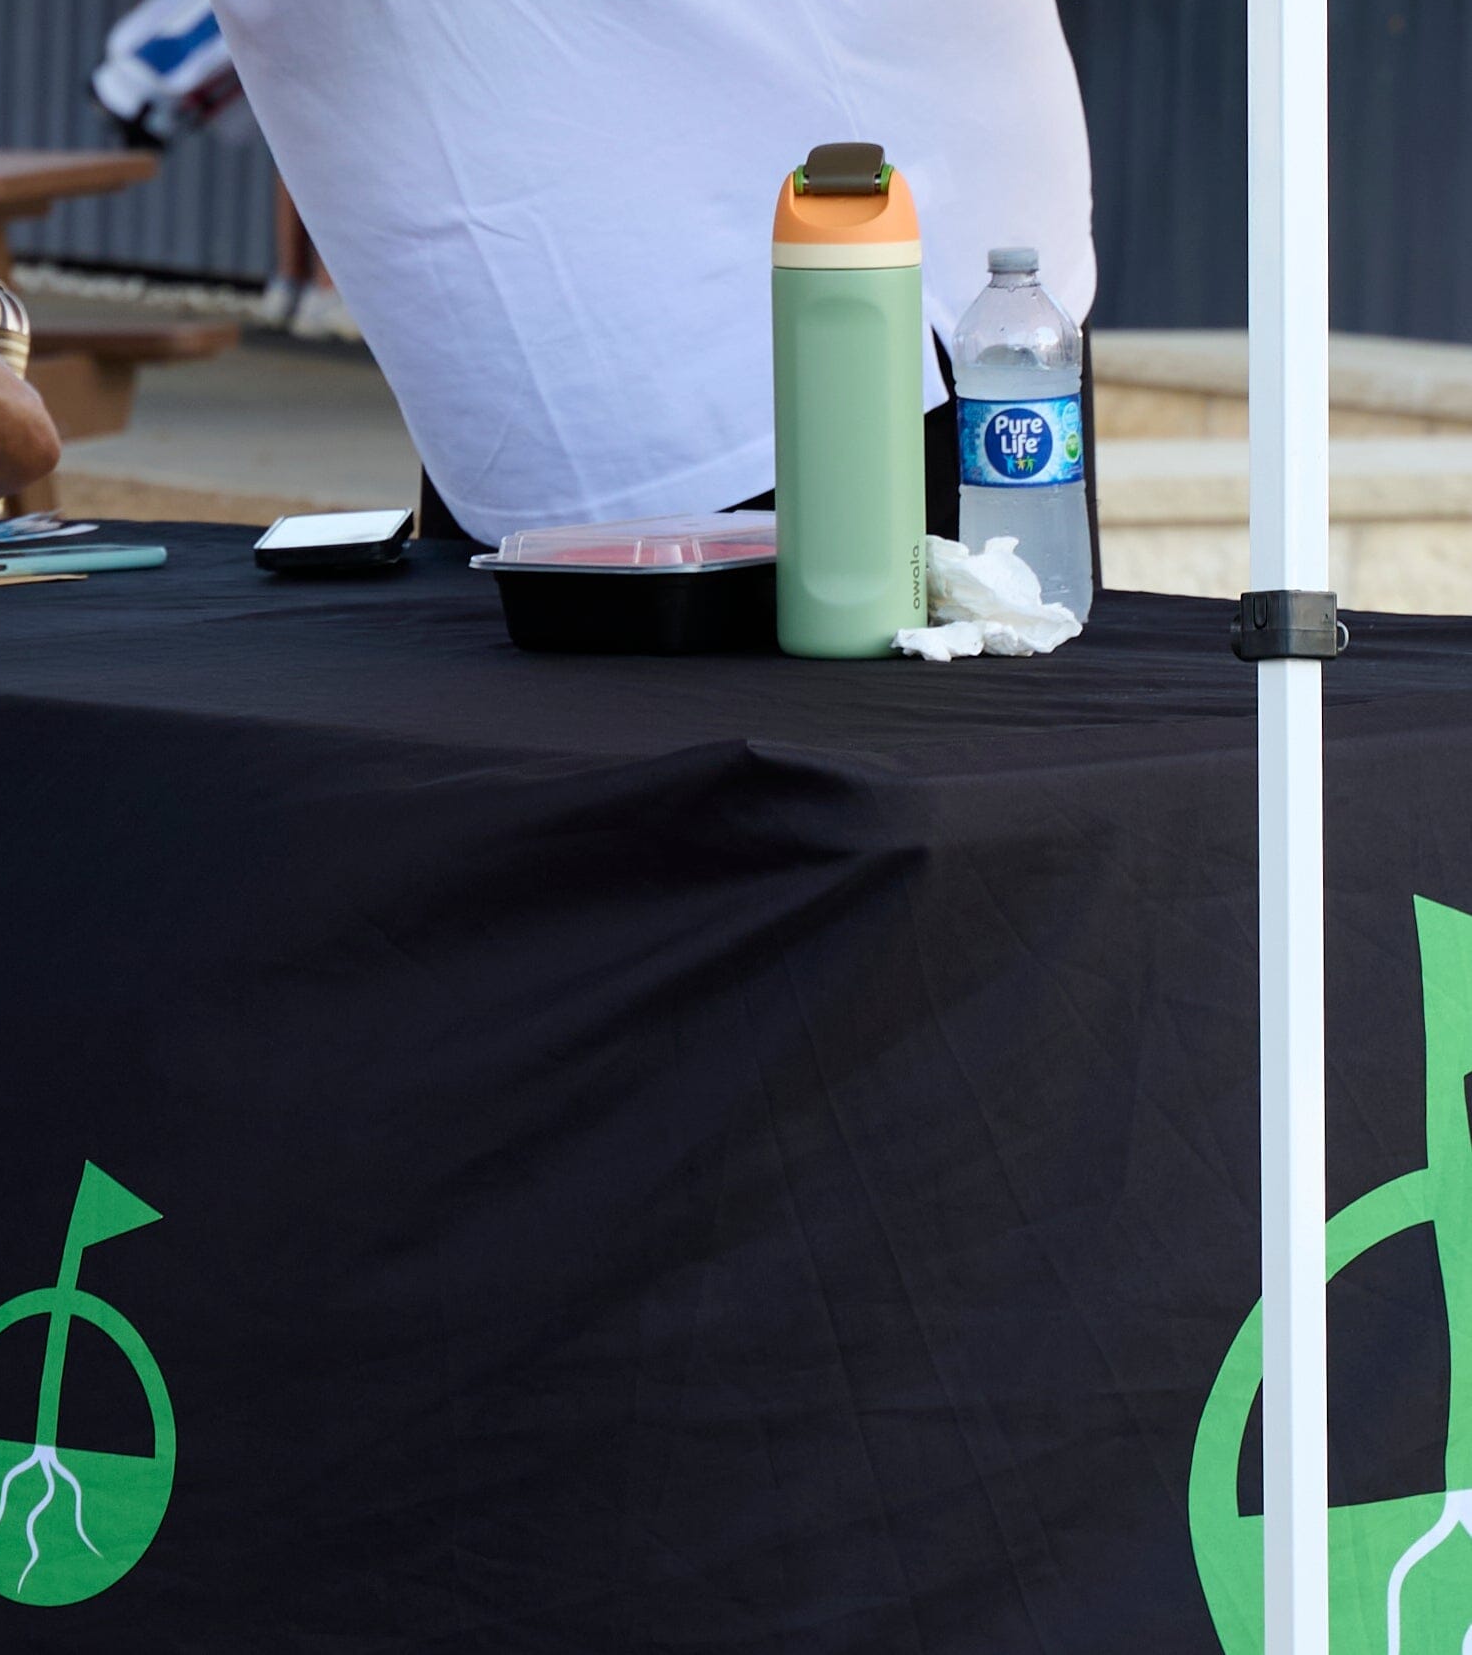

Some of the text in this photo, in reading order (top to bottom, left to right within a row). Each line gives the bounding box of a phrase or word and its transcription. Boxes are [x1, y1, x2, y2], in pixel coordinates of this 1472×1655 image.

[995, 415, 1043, 434] Pure
[1000, 435, 1038, 458] Life
[910, 544, 921, 610] owala
